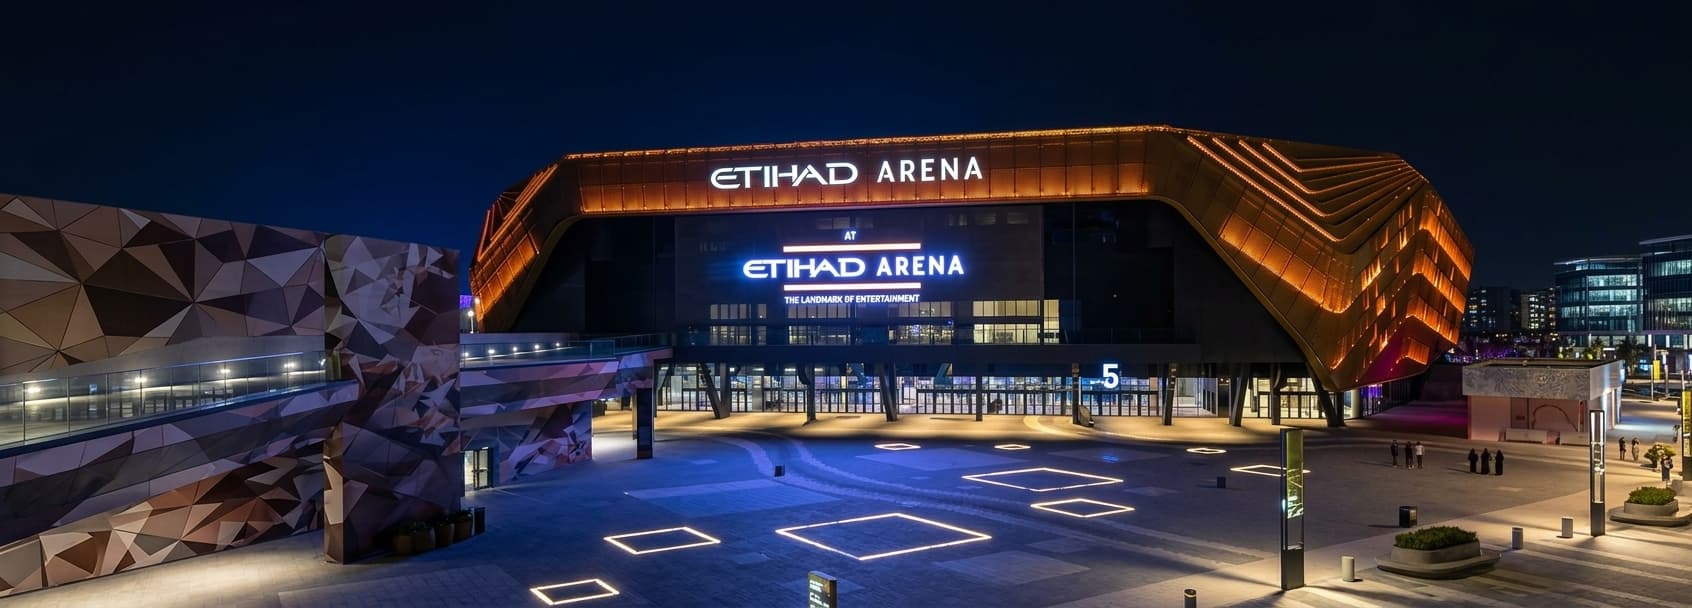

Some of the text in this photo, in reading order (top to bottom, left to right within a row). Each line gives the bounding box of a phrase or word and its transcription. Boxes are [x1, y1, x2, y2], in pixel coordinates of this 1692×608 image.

[710, 156, 983, 190] ETIHAD ARENA
[844, 231, 857, 241] AT
[742, 255, 965, 278] ETIHAD ARENA
[784, 293, 920, 304] THE LANDMARK OF ENTERTAINMENT
[1103, 364, 1119, 389] 5
